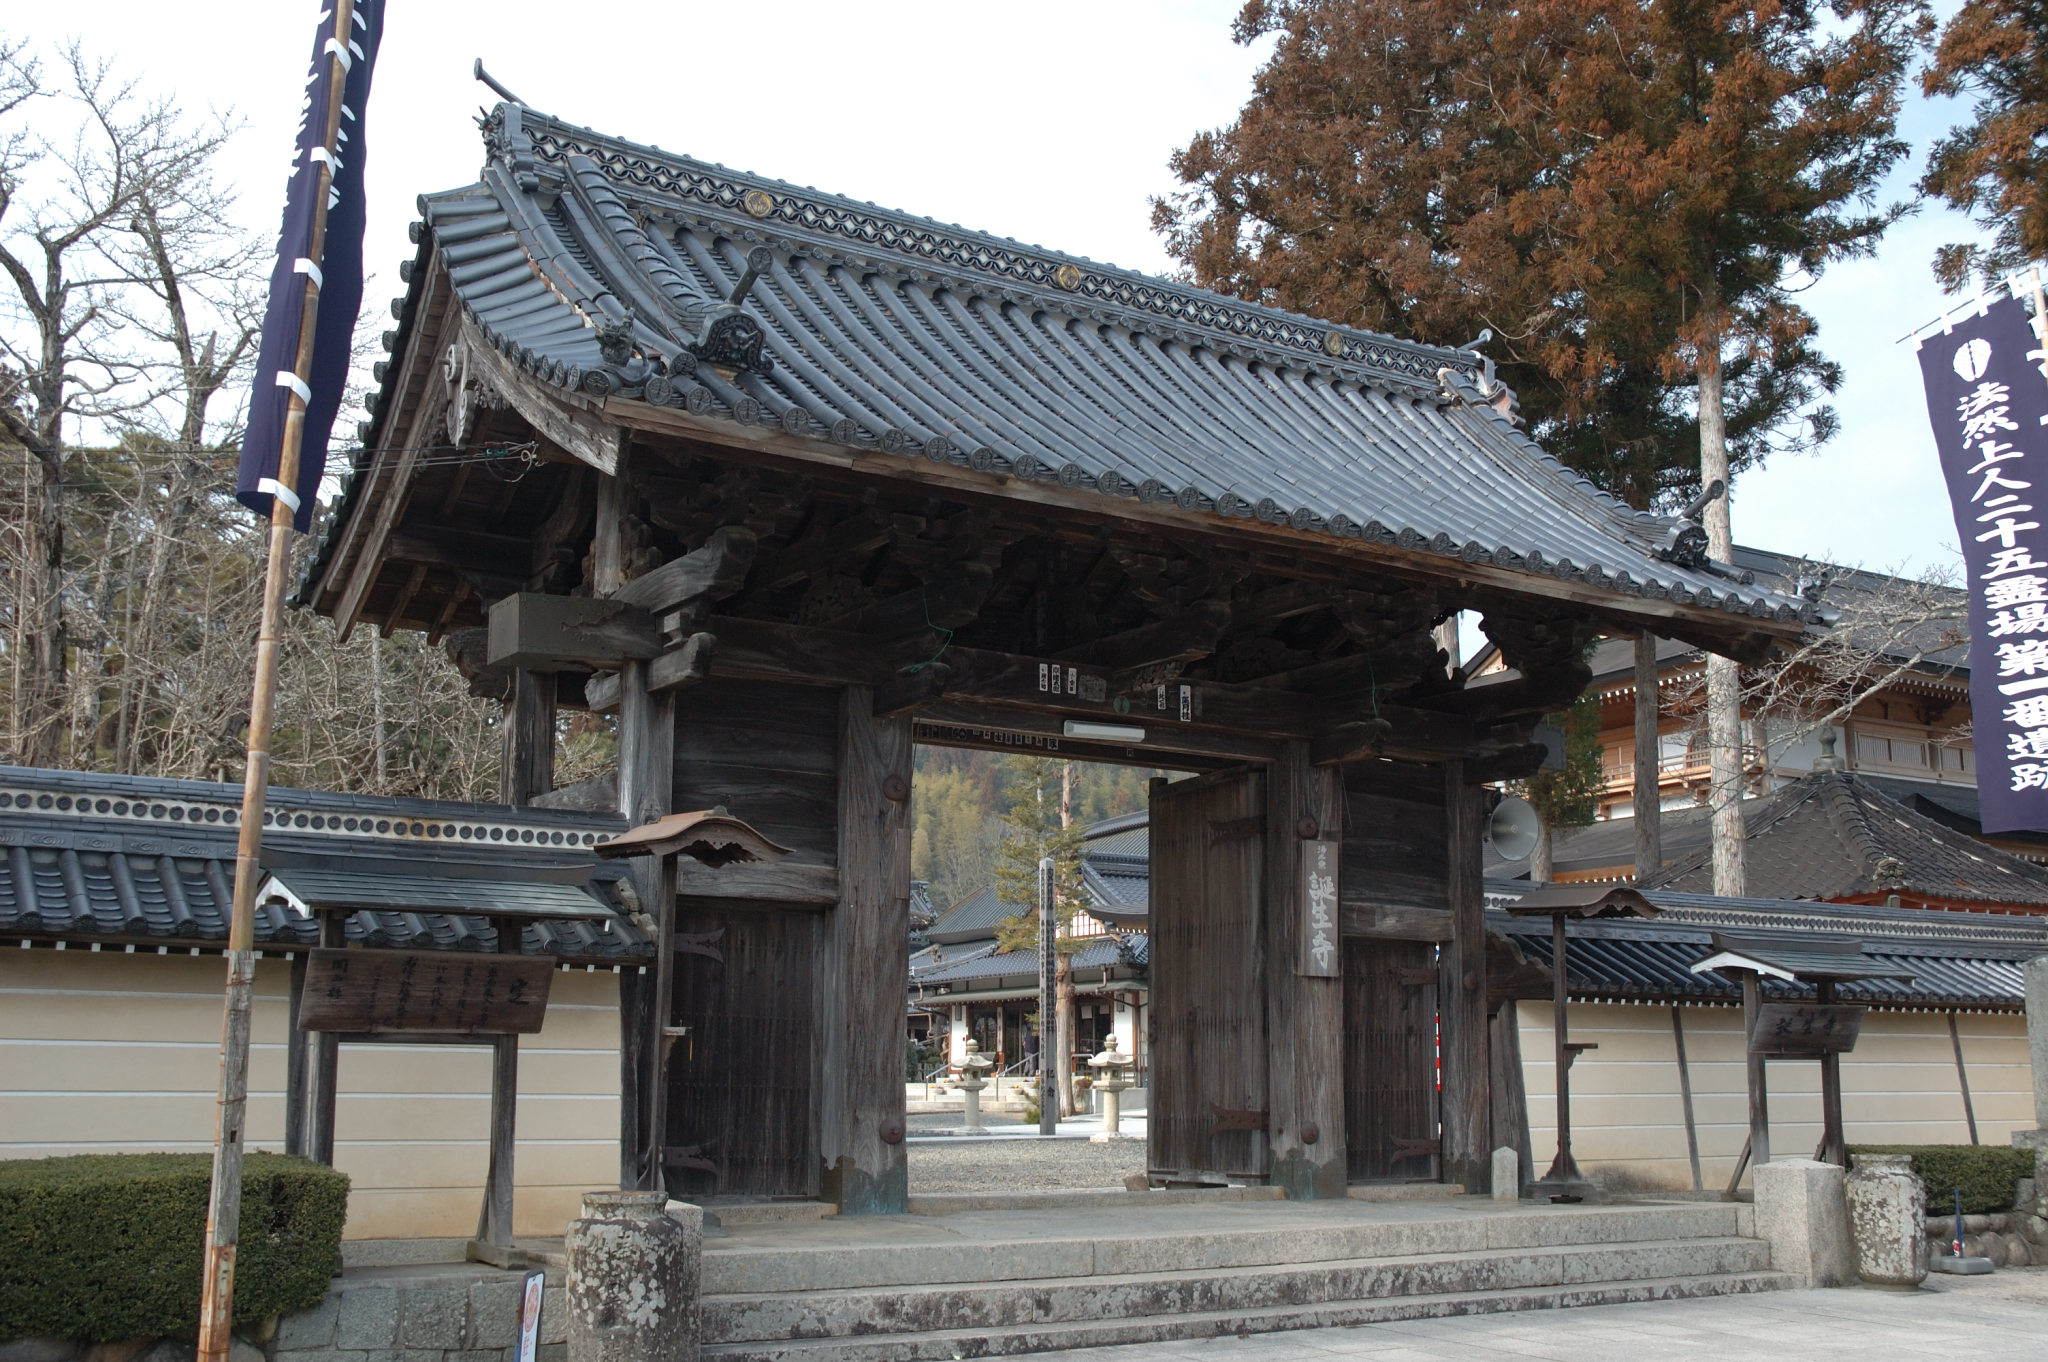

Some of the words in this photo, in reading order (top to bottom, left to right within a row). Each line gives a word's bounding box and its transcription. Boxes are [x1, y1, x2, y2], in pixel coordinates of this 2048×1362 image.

[1309, 871, 1337, 969] 誕生寺
[508, 978, 530, 1006] 定
[1046, 1068, 1055, 1098] 記念
